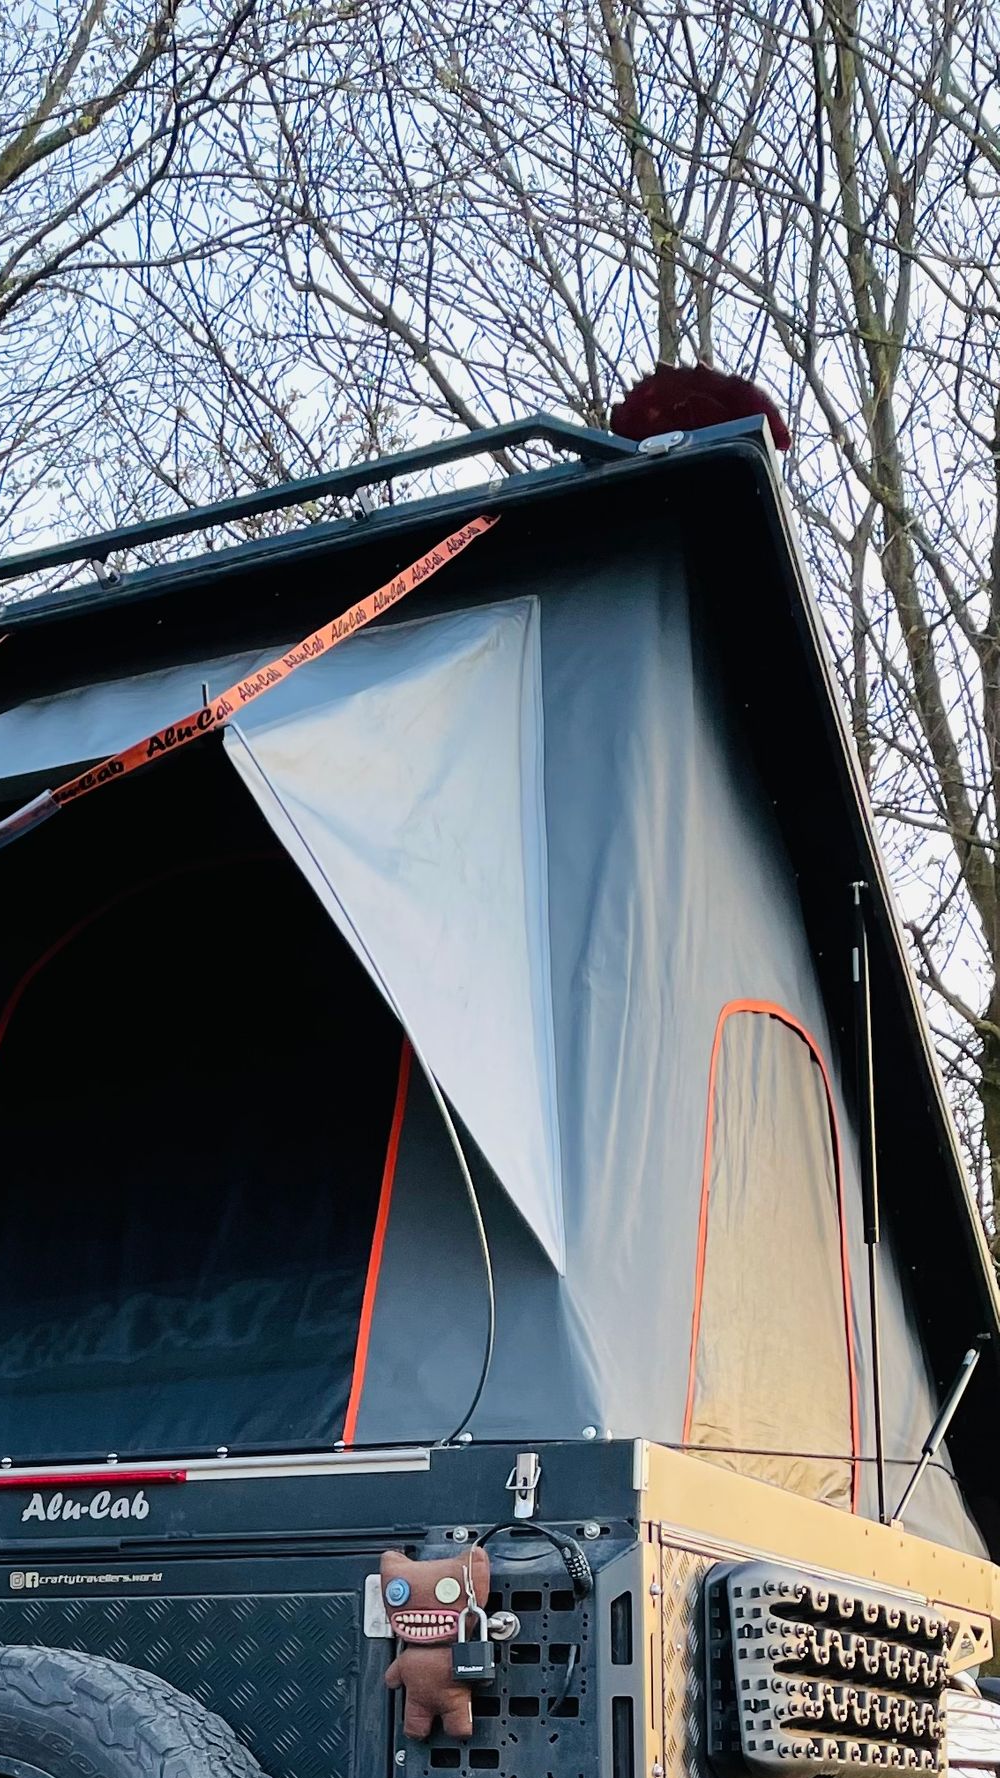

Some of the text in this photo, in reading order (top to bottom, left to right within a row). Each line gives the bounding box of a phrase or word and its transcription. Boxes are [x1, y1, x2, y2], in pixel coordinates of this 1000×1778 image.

[237, 667, 282, 701] Alu-Cab
[146, 697, 234, 757] Alu-Cab
[21, 1490, 150, 1522] Alu-Cab
[39, 1573, 163, 1585] craftytravellers.world
